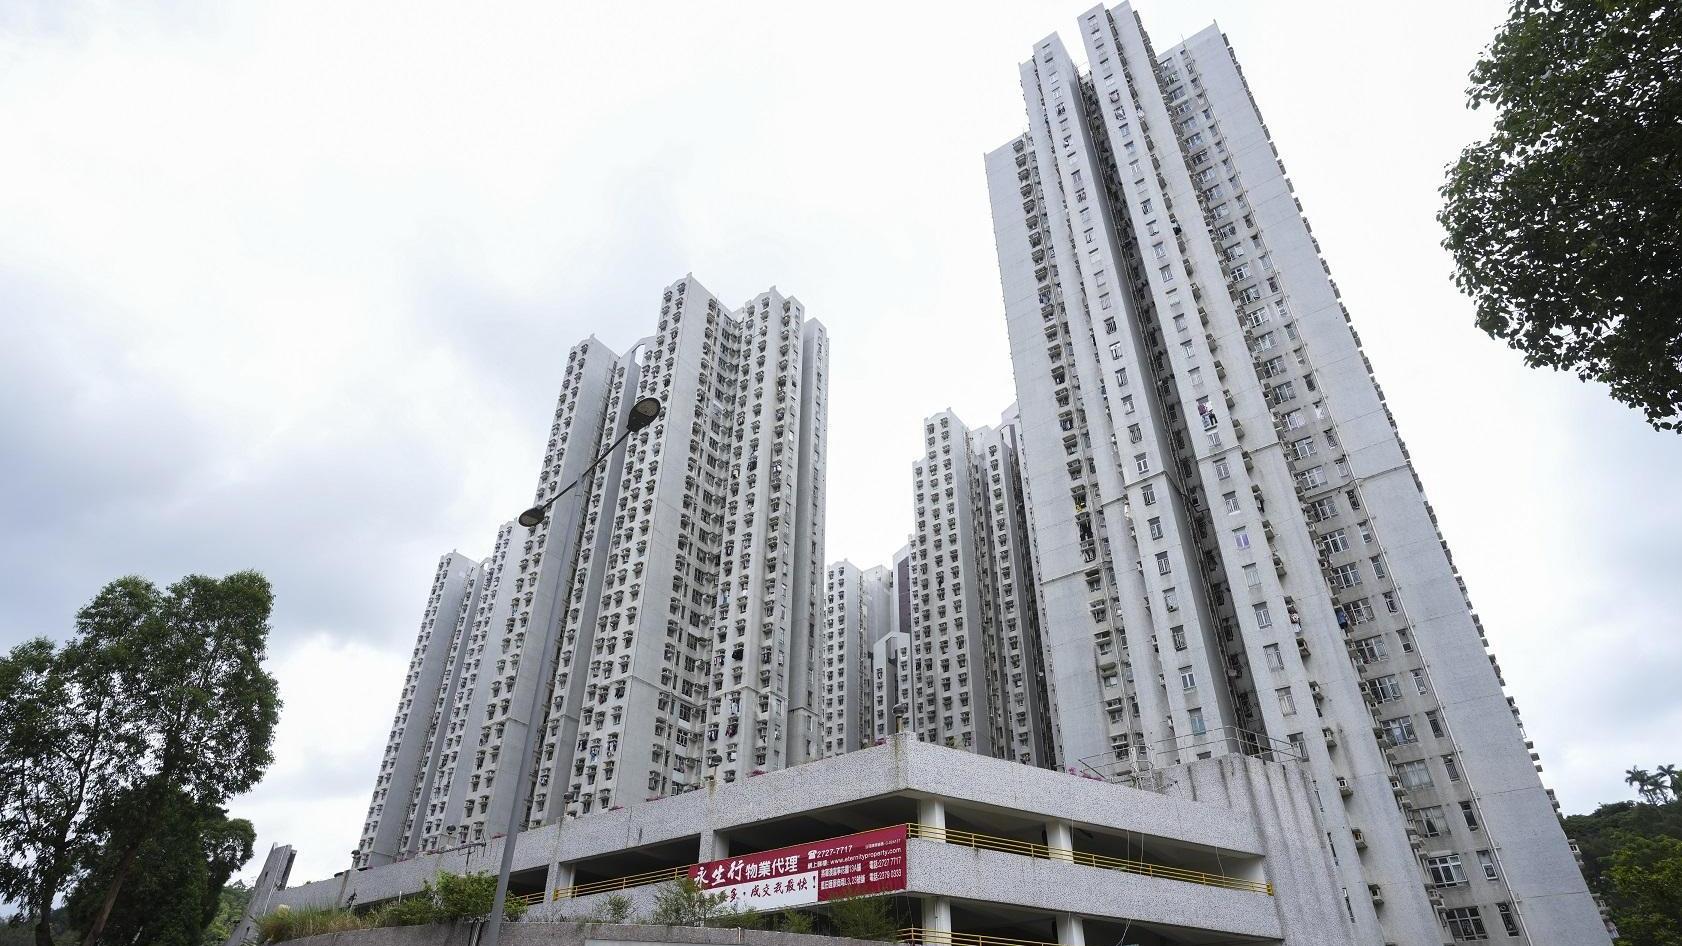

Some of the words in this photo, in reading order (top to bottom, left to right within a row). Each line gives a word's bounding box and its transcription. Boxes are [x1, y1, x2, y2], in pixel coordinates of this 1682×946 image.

[817, 845, 852, 857] 2727-7717
[830, 848, 902, 865] www.eternityproperty.com
[694, 855, 798, 888] 永生行物業代理
